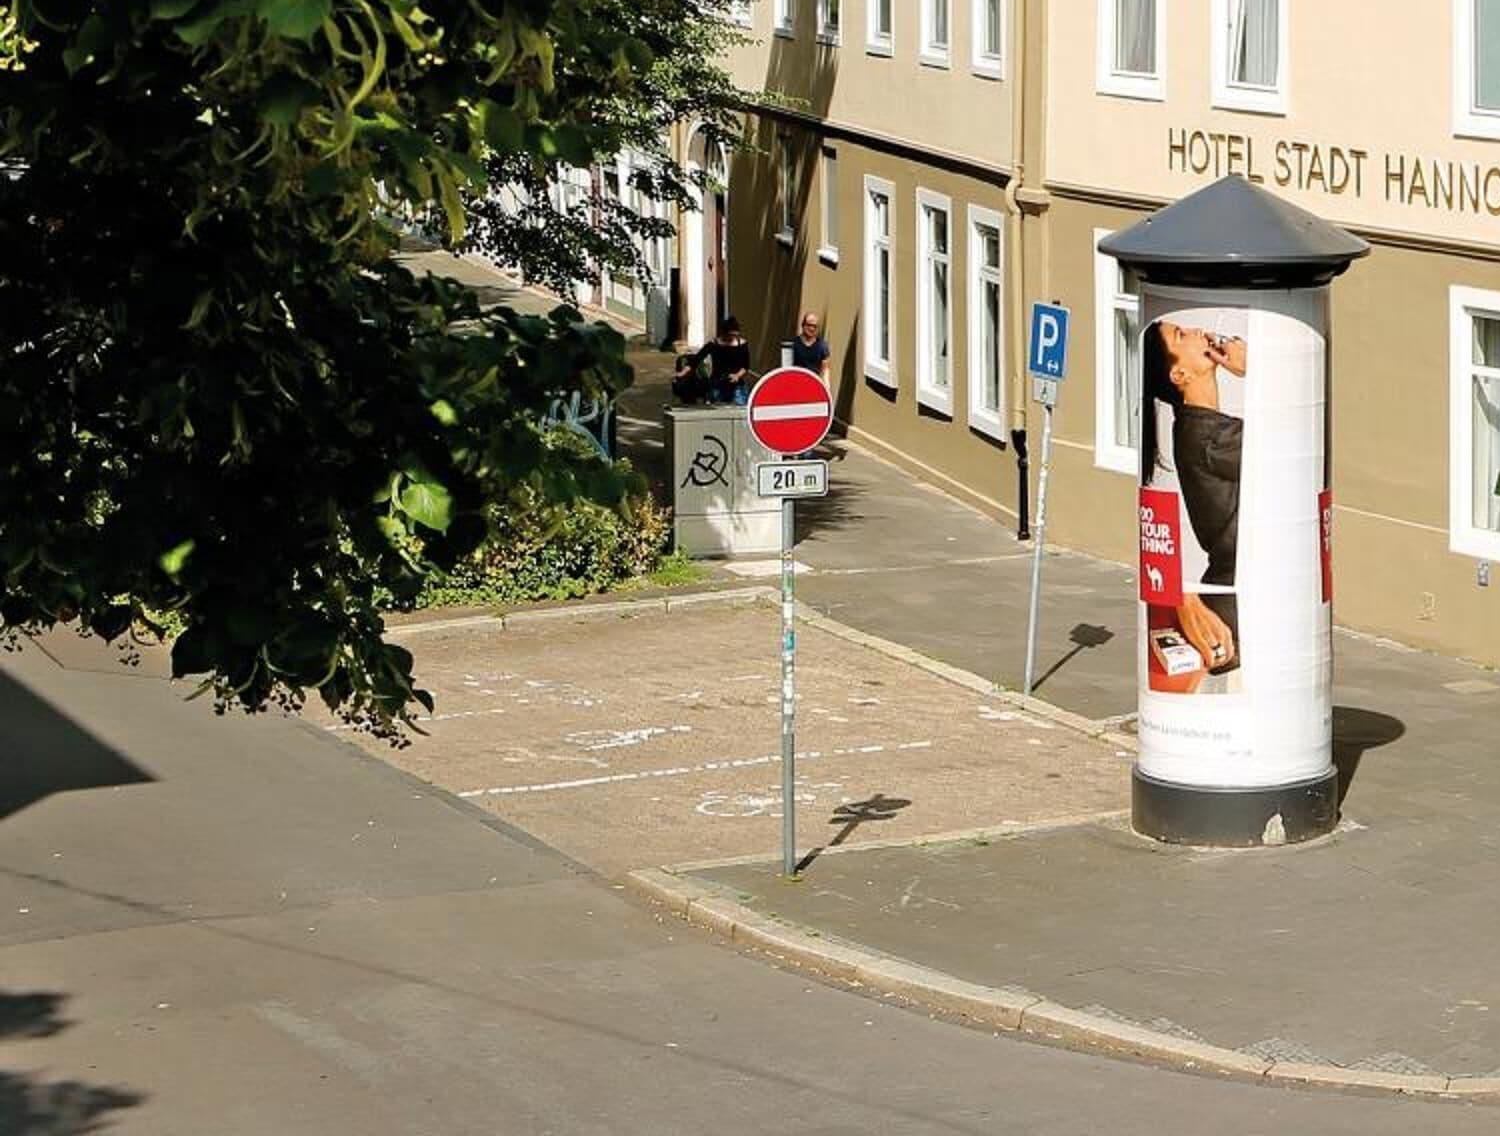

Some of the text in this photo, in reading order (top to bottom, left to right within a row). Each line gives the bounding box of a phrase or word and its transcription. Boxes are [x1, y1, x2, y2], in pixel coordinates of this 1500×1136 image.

[1168, 127, 1265, 184] HOTEL
[1274, 140, 1368, 198] STADT
[1037, 313, 1059, 365] P
[773, 469, 817, 489] 20 m
